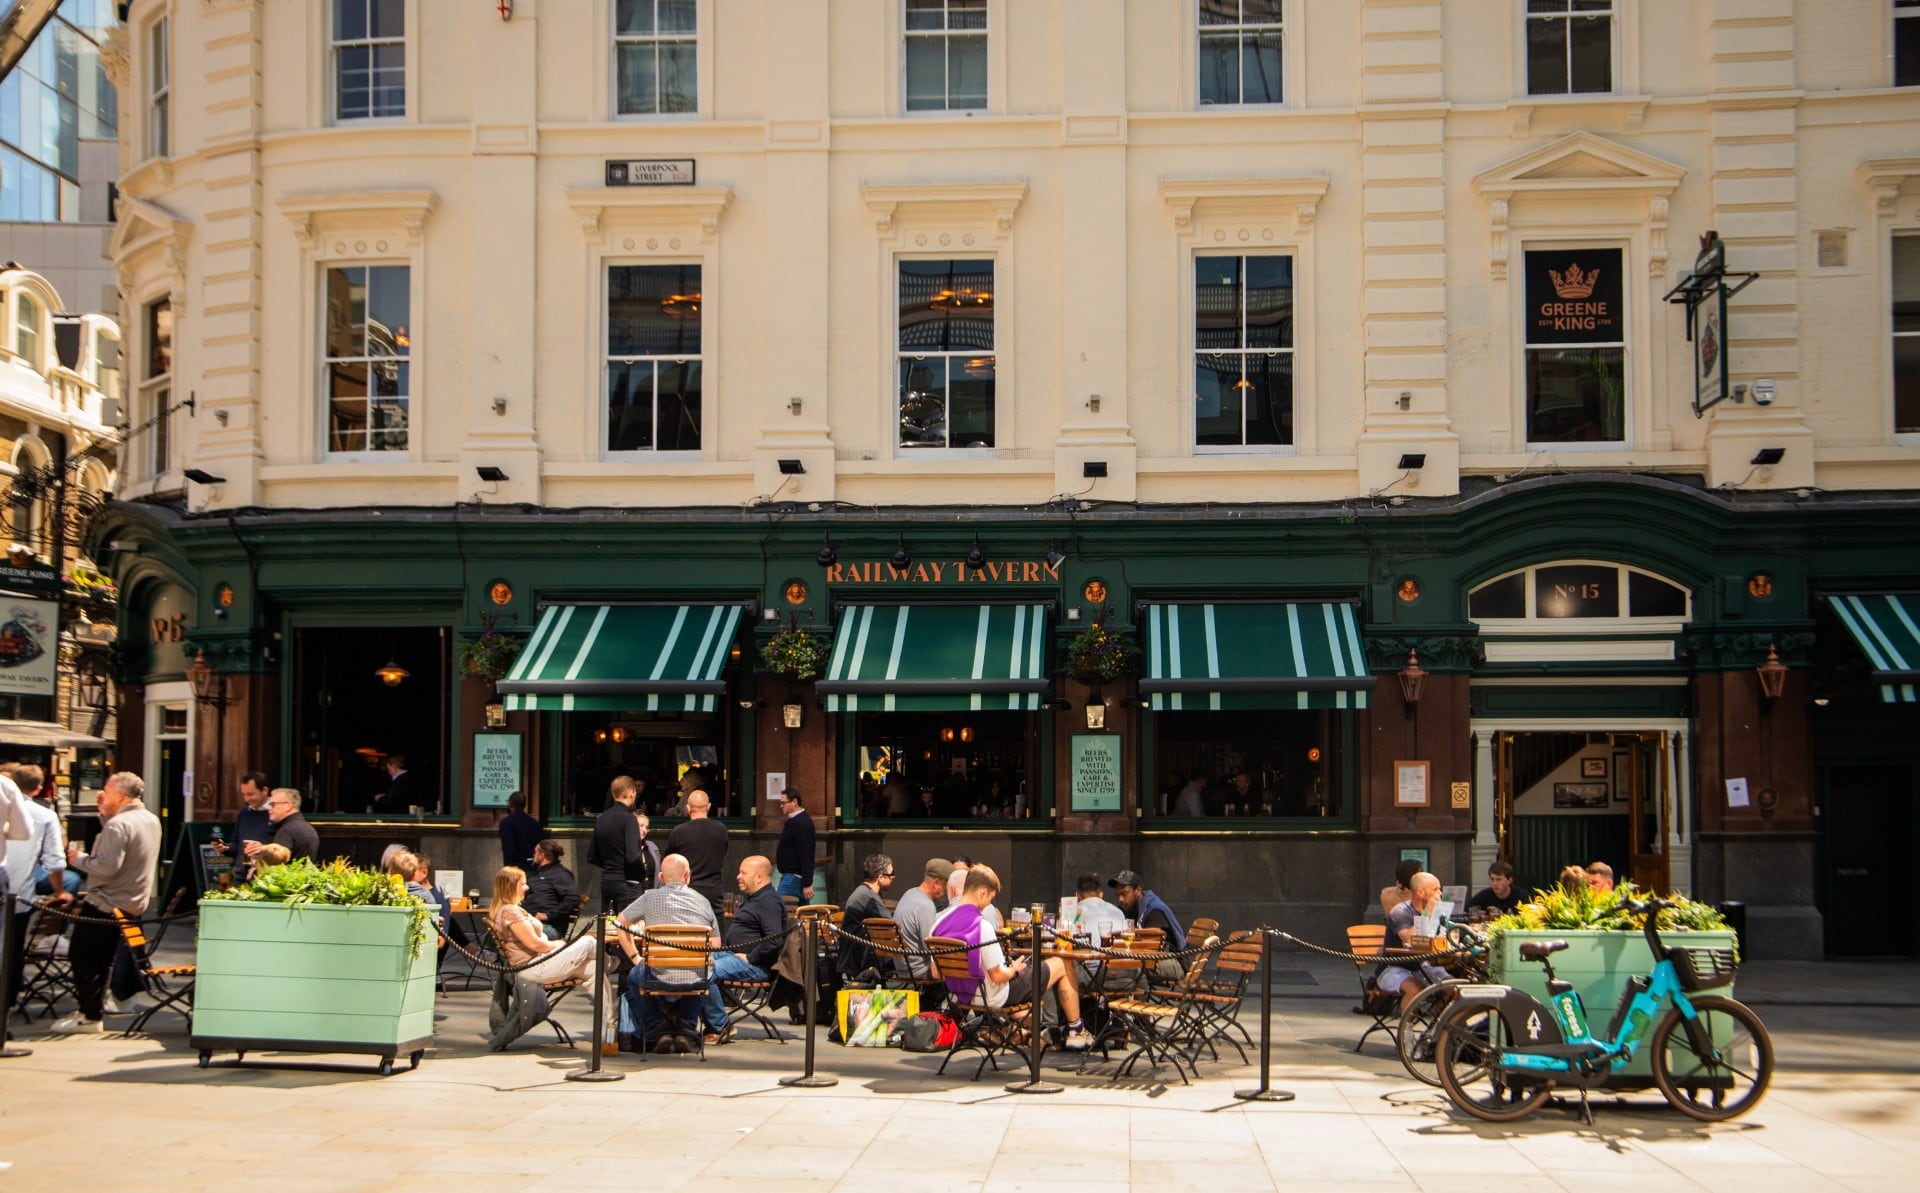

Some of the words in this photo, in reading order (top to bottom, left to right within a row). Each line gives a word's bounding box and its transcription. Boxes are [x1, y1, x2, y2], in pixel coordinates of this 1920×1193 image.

[634, 164, 679, 172] LIVERPOOL
[634, 173, 663, 181] STREET
[1541, 302, 1608, 316] GREENE
[1554, 316, 1596, 331] KING
[826, 562, 947, 583] RAILWAY
[953, 562, 1060, 583] TAVERN
[1580, 583, 1600, 599] 15
[1561, 996, 1583, 1037] forest
